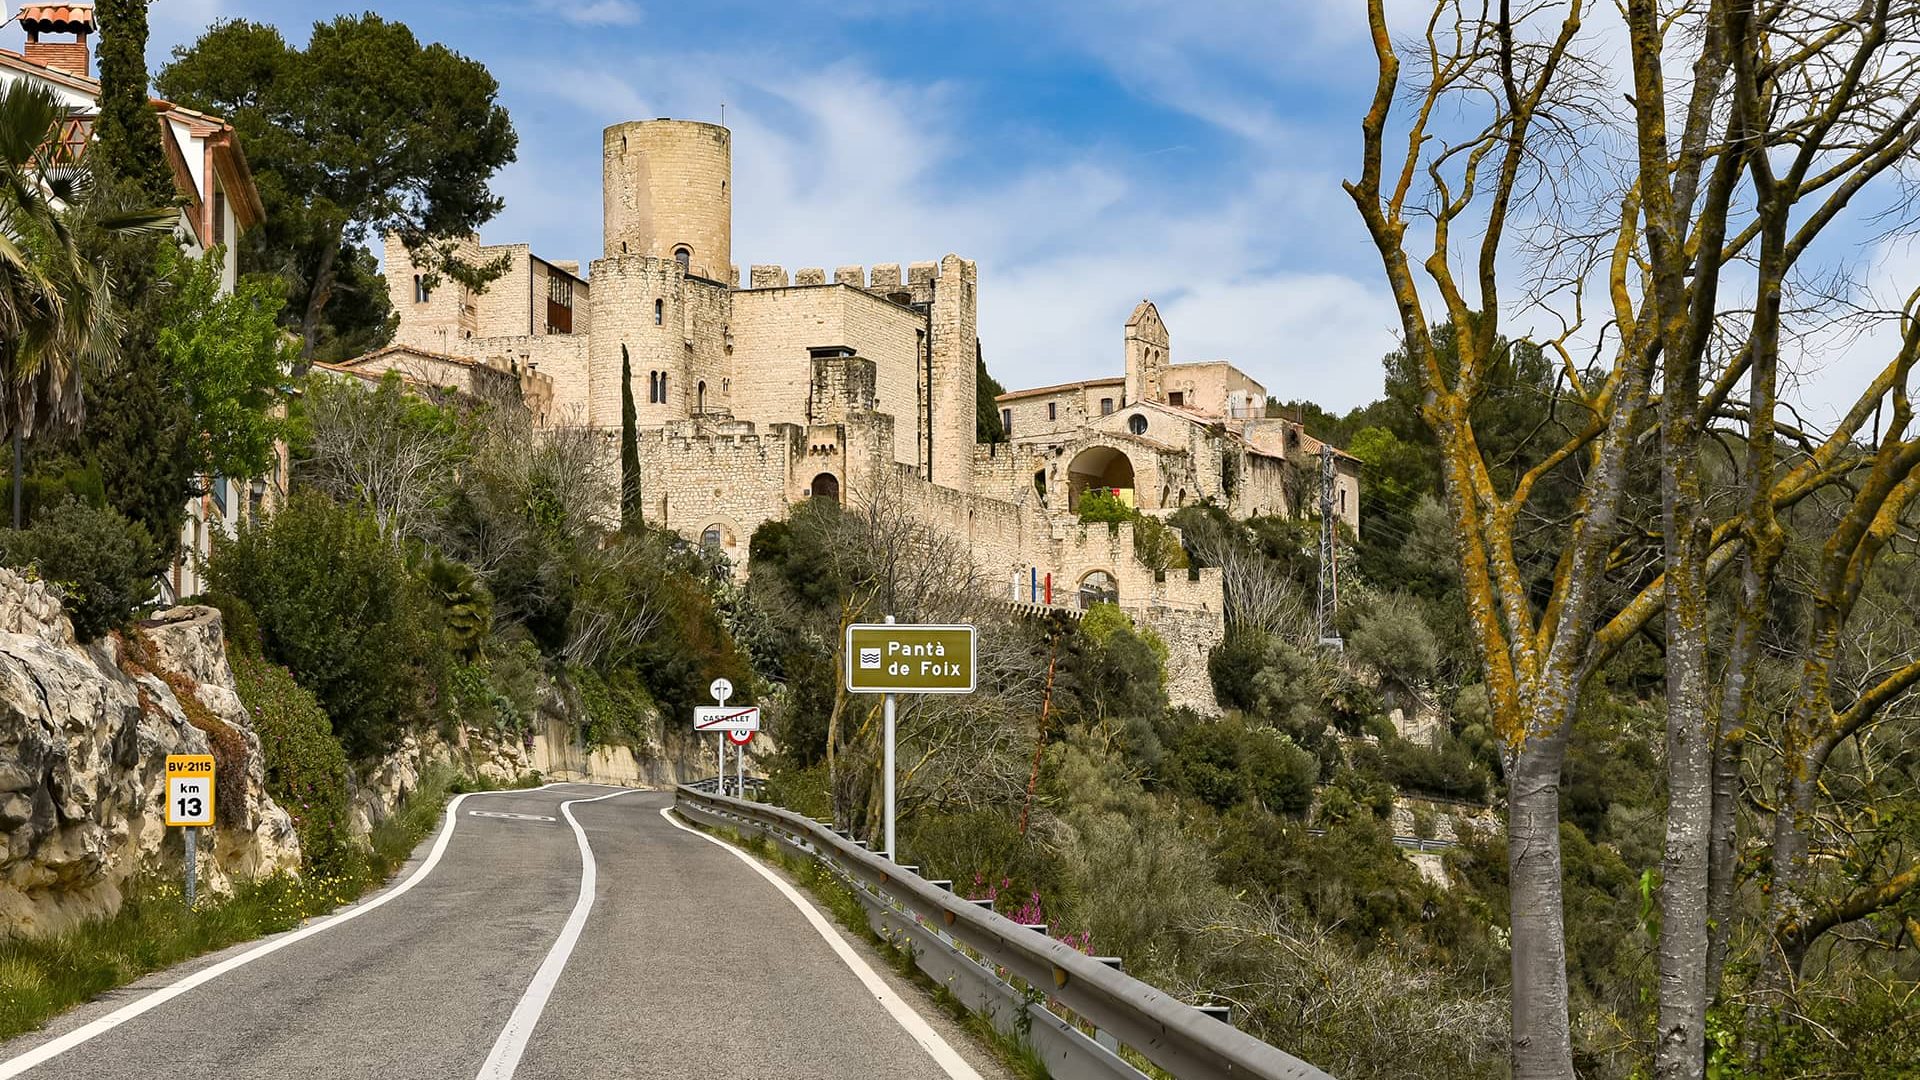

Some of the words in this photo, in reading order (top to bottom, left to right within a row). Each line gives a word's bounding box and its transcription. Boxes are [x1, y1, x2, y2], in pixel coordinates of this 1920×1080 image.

[888, 641, 945, 656] Pantà
[888, 661, 910, 676] de
[921, 661, 960, 676] Foix
[169, 762, 211, 772] BV-2115
[180, 783, 199, 793] km
[178, 798, 202, 816] 13
